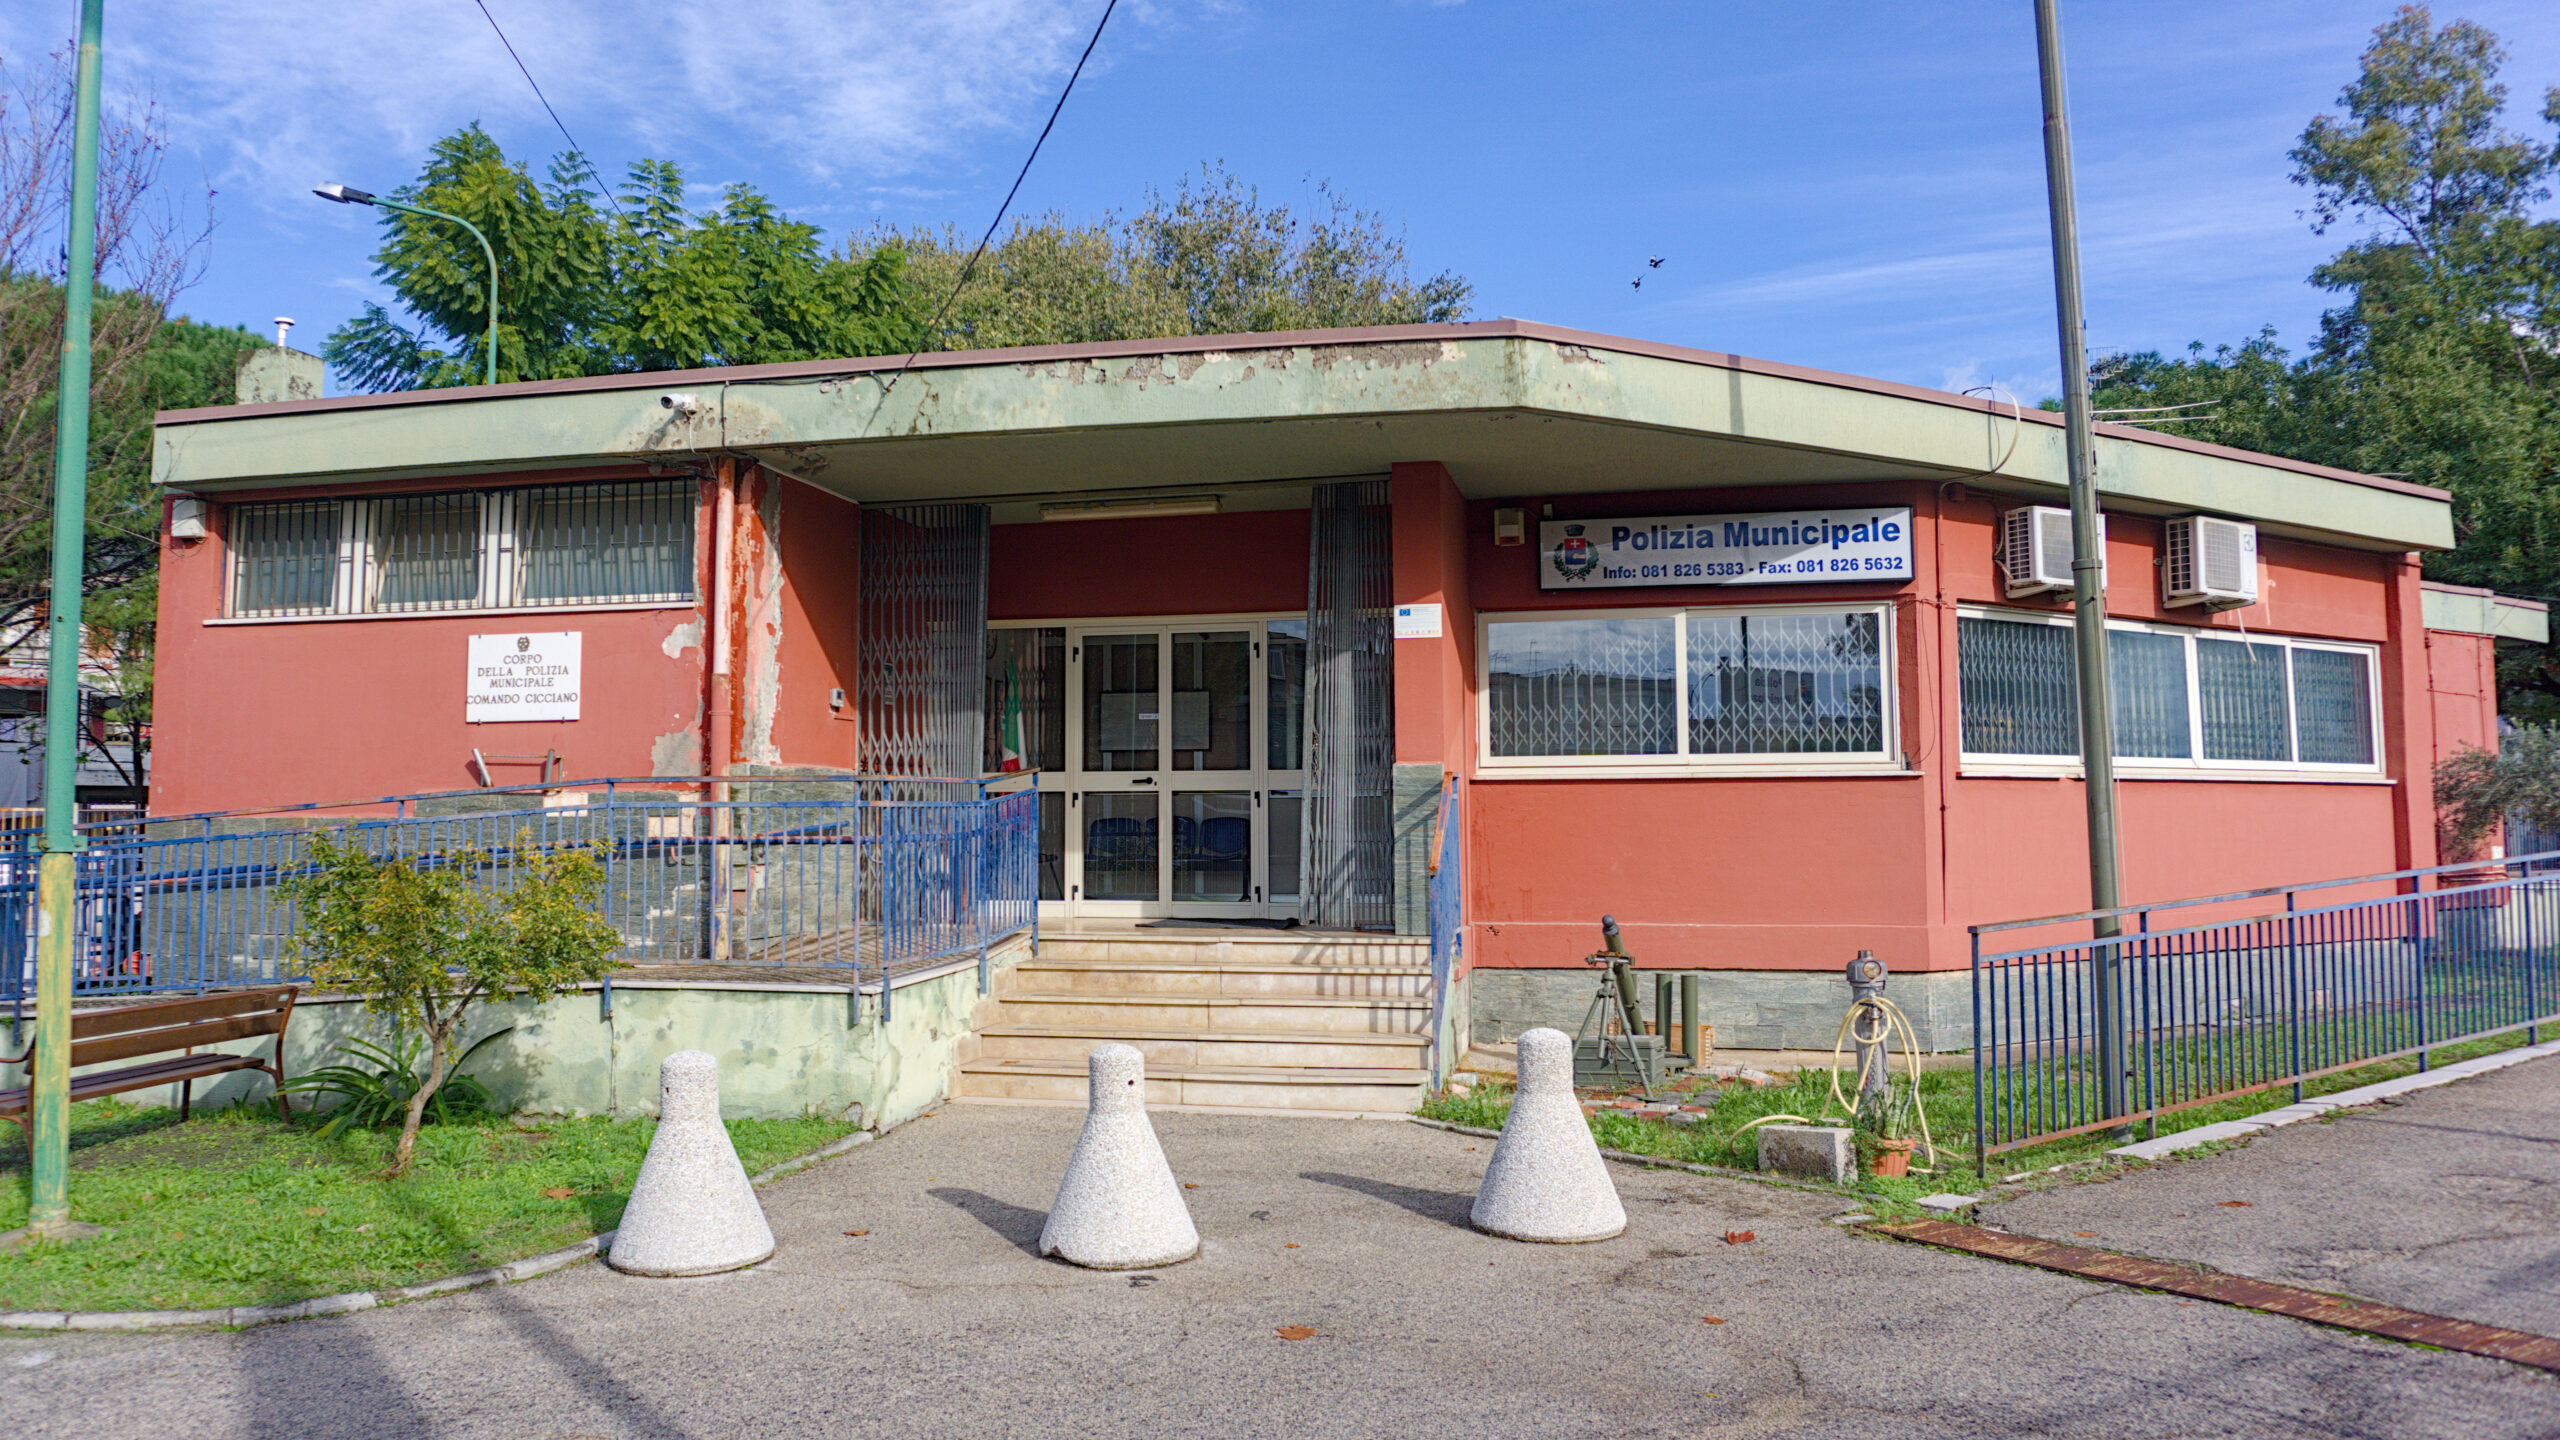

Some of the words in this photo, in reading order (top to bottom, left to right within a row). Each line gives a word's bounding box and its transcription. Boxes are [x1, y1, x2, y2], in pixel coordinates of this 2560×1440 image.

[1611, 523, 1714, 551] Polizia
[1723, 516, 1901, 550] Municipale
[1602, 565, 1637, 579] Info:
[1641, 564, 1668, 578] 081
[1674, 563, 1702, 577] 826
[1706, 562, 1744, 576] 5383
[1758, 560, 1792, 574] Fax:
[1796, 559, 1824, 573] 081
[1829, 557, 1859, 572] 826
[1863, 556, 1904, 571] 5632
[503, 654, 542, 665] CORPO
[477, 667, 513, 677] DELLA
[525, 665, 569, 676] POLIZIA
[489, 677, 555, 688] MUNICIPALE
[466, 693, 520, 705] COMANDO
[525, 692, 578, 703] CICCIANO
